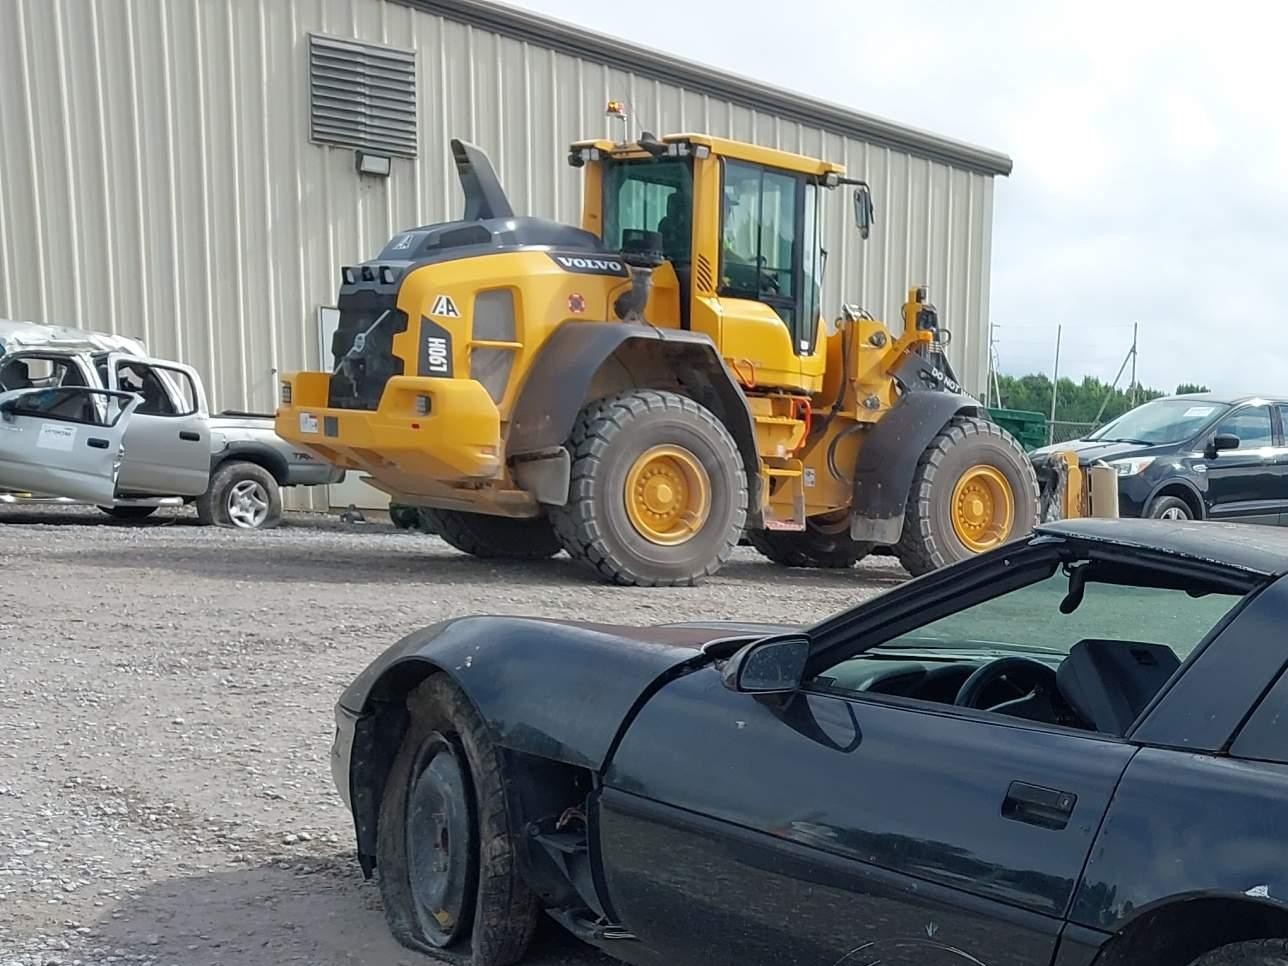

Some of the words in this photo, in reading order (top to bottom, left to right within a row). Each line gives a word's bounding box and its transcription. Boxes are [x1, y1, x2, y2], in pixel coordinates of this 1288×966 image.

[557, 257, 622, 271] VOLVO
[427, 337, 447, 372] L90H
[944, 377, 960, 392] NOT
